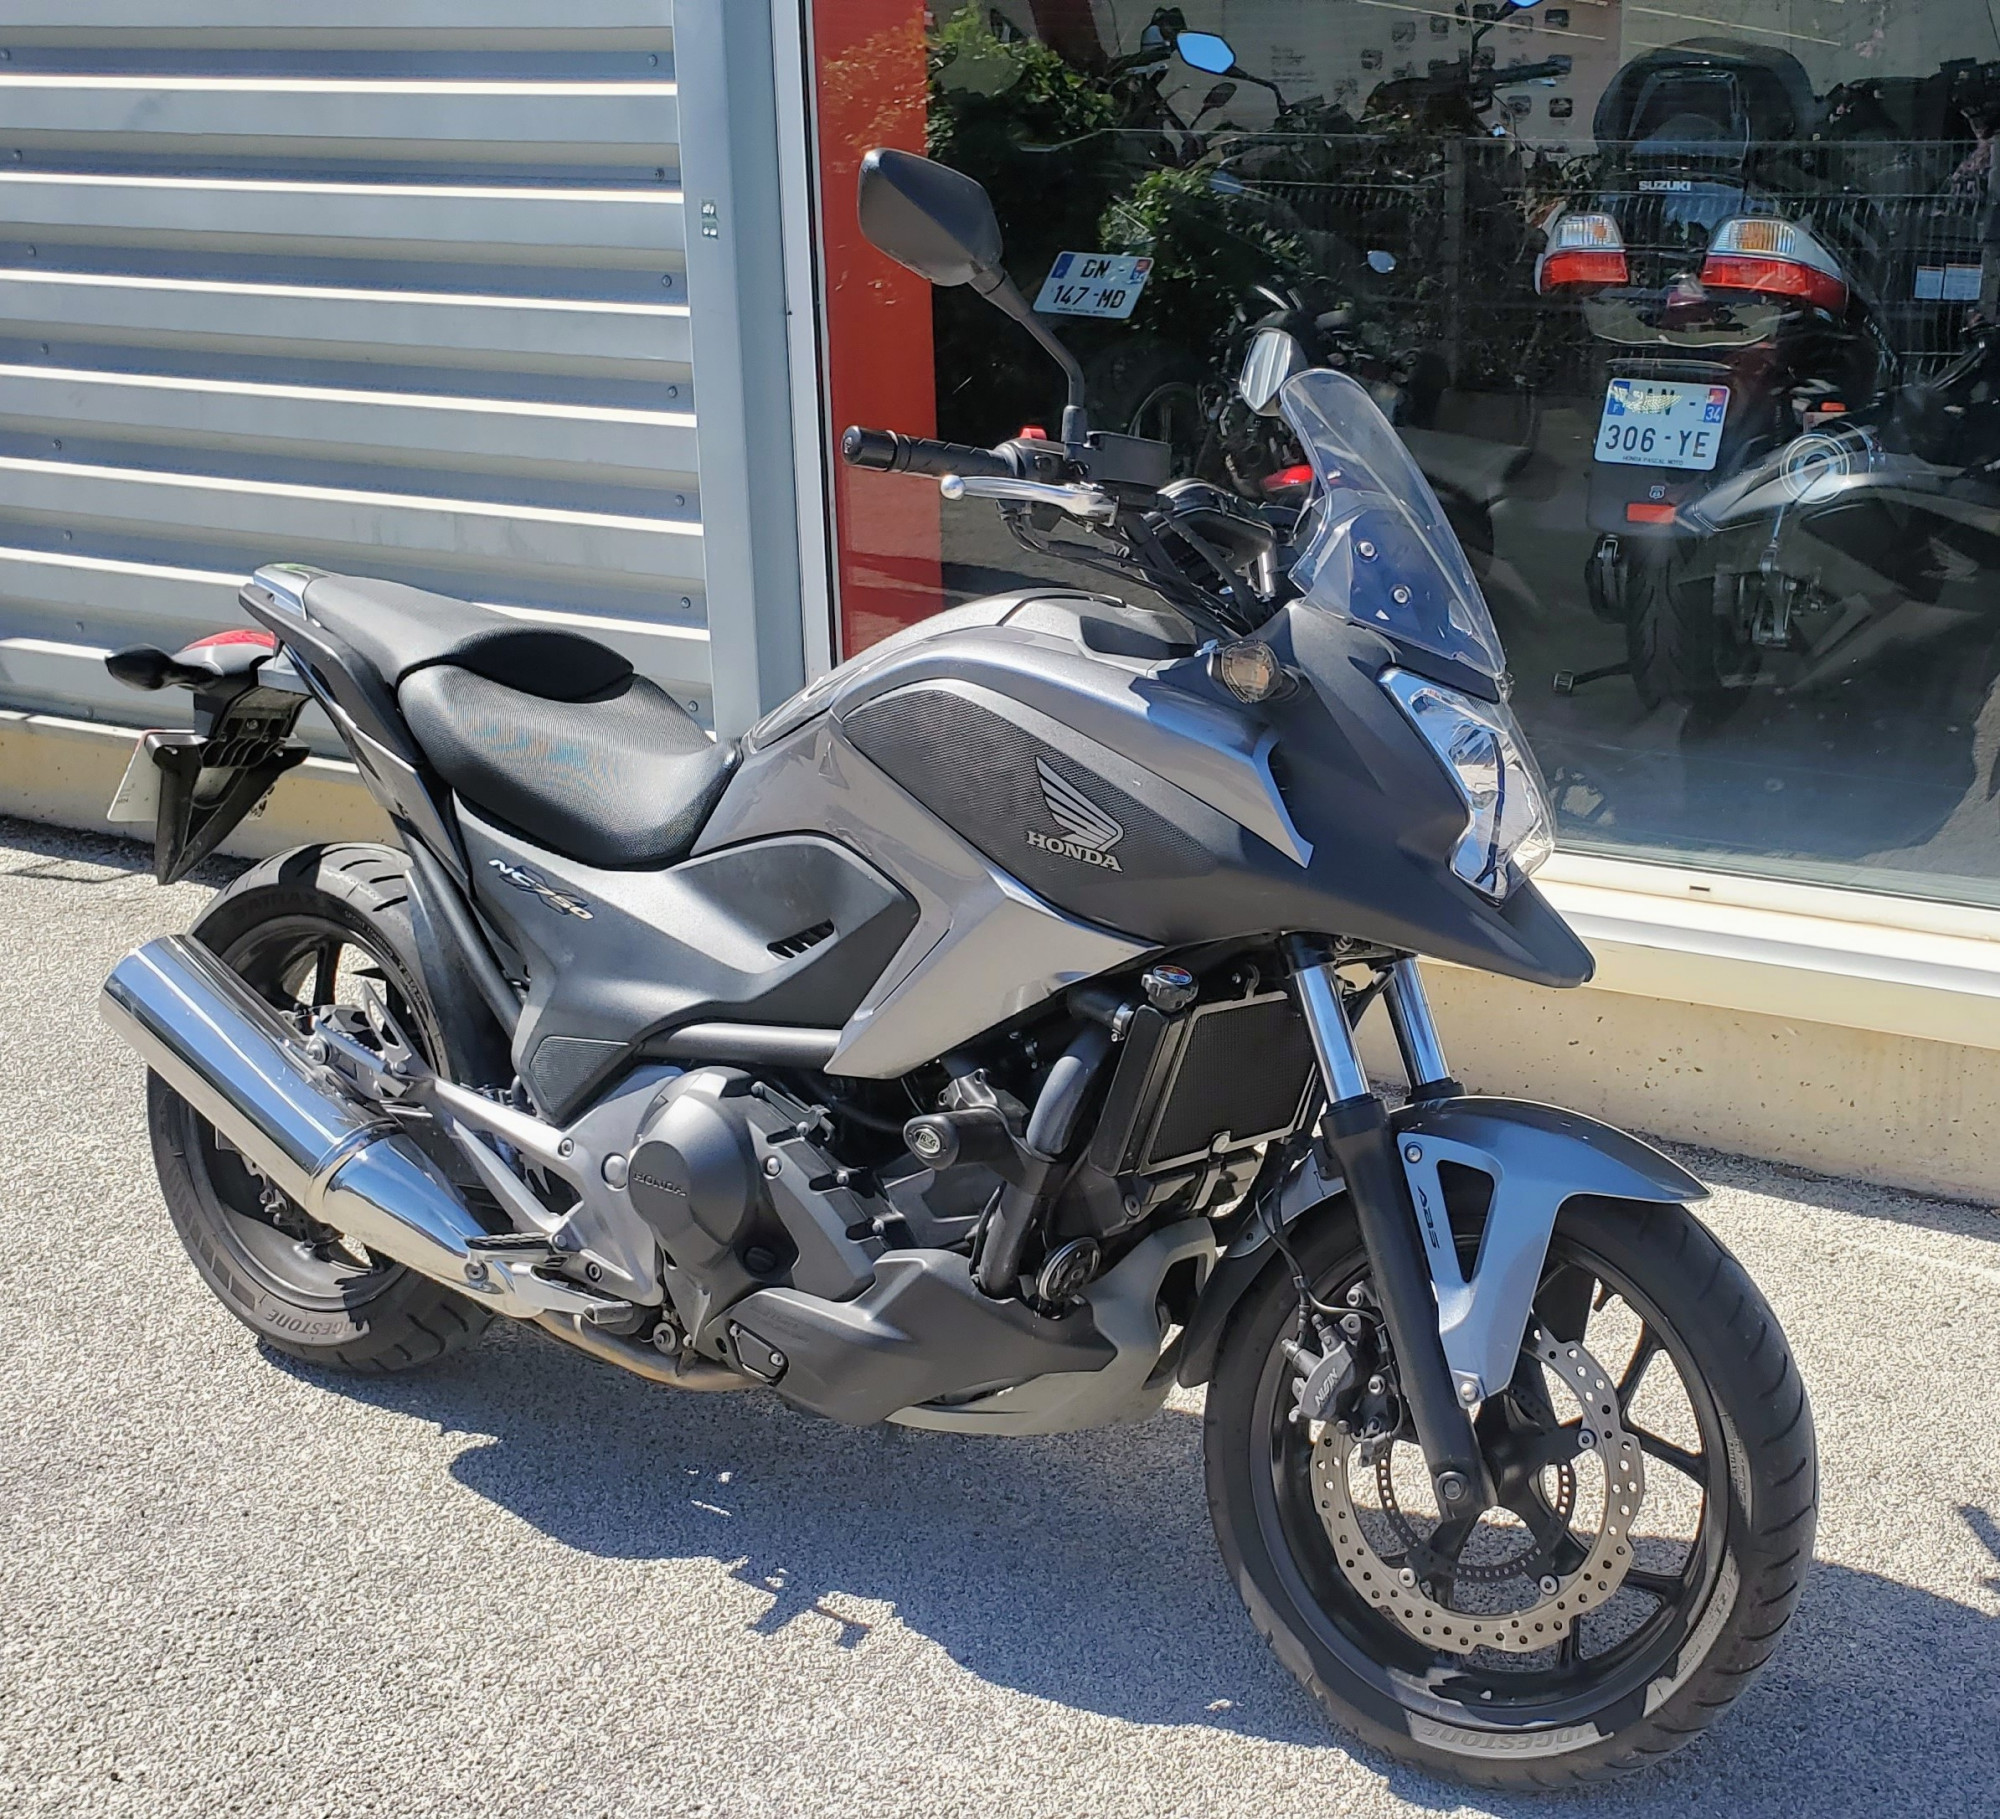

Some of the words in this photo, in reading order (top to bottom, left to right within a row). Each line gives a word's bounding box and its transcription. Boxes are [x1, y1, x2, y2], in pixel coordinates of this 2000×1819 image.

[1638, 180, 1692, 192] SUZUKI
[1705, 406, 1721, 422] 34
[1604, 424, 1711, 458] 306-YE
[1026, 830, 1124, 873] HONDA
[633, 1172, 687, 1197] HONDA
[1416, 1185, 1440, 1249] ABS
